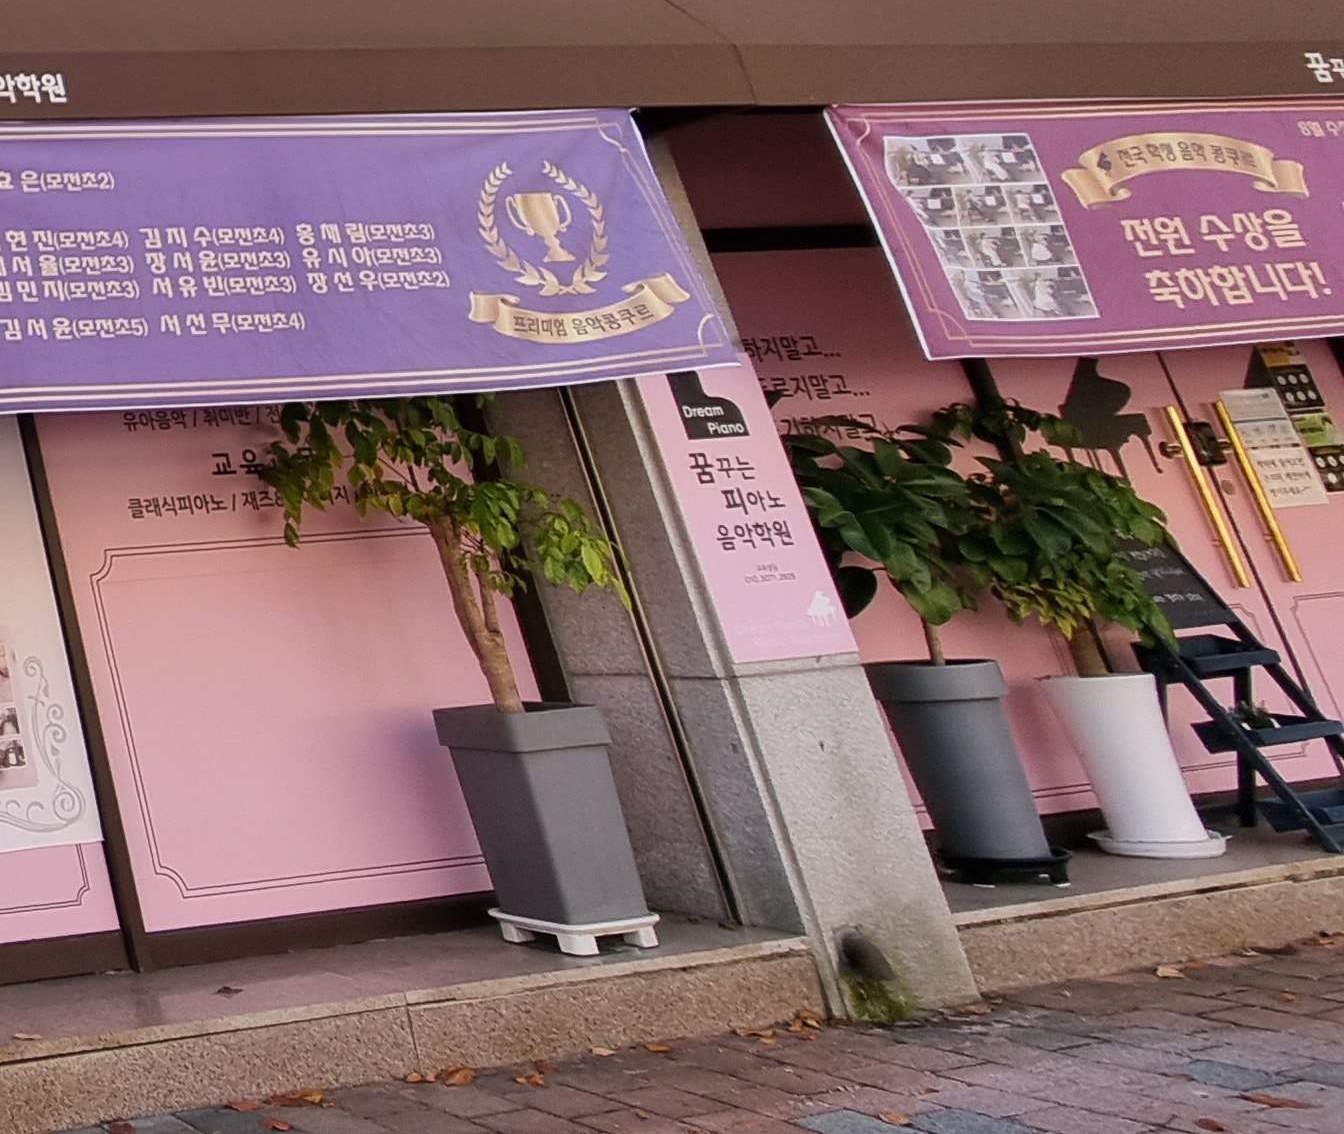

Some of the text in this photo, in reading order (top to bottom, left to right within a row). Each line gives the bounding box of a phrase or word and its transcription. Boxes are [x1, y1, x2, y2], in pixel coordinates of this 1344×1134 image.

[1119, 208, 1308, 259] 전원 수상을
[1144, 261, 1332, 310] 축하합니다!
[513, 304, 655, 337] 프리미엄 음악콩쿠르
[123, 411, 188, 432] 유아음악
[683, 405, 725, 418] Dream
[707, 422, 745, 435] Piano
[688, 452, 756, 485] 꿈꾸는
[127, 494, 227, 519] 클래식피아노
[720, 487, 786, 515] 피아노
[715, 520, 795, 552] 음악학원
